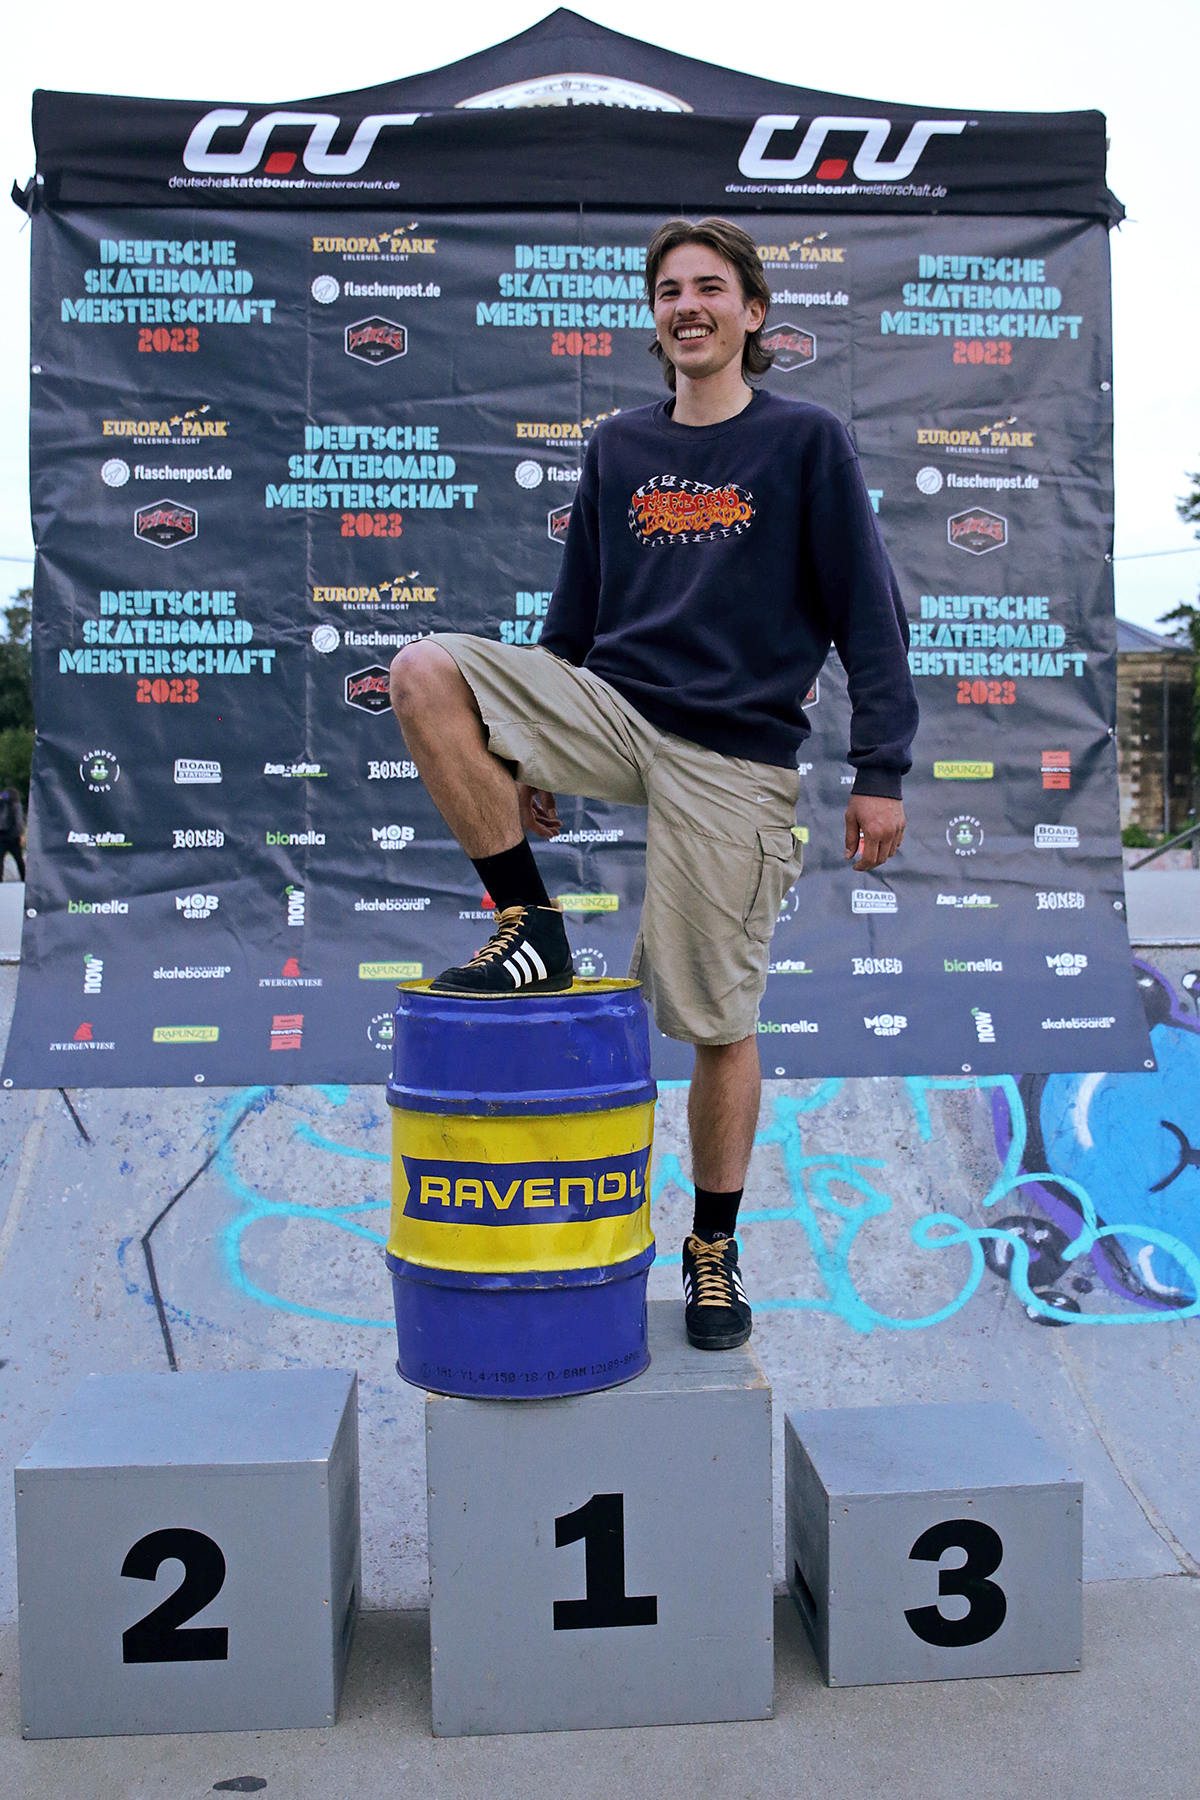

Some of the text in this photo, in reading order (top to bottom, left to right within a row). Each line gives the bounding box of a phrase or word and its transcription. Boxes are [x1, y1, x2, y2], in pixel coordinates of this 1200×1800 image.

[100, 238, 236, 265] DEUTSCHE
[313, 236, 438, 256] EUROPA PARK
[757, 245, 845, 263] OPA PARK
[515, 245, 648, 271] DEUTSCHE
[918, 254, 1046, 282] DEUTSCHE
[84, 269, 253, 294] SKATEBOARD
[344, 282, 440, 299] flaschenpost.de
[499, 273, 648, 299] SKATEBOAR
[771, 289, 849, 307] schenpost.de
[902, 284, 1061, 311] SKATEBOARD
[61, 298, 276, 323] MEISTERSCHAFT
[477, 302, 656, 329] MEISTERSCHA
[881, 308, 1082, 339] MEISTERSCHAFT
[138, 328, 199, 352] 2023
[551, 331, 612, 356] 2023
[953, 341, 1012, 365] 2023
[103, 420, 228, 437] EUROPA PARK
[305, 425, 439, 450] DEUTSCHE
[516, 423, 583, 438] EUROPA
[917, 429, 1036, 447] EUROPA PARK
[134, 465, 232, 483] flaschenpost.de
[288, 454, 455, 479] SKATEBOARD
[947, 474, 1039, 491] flaschenpost.de
[266, 484, 478, 508] MEISTERSCHAFT
[341, 513, 402, 537] 2023
[100, 591, 236, 615] DEUTSCHE
[313, 586, 436, 602] EUROPA PARK
[920, 596, 1049, 620] DEUTSCHE
[83, 620, 253, 644] SKATEBOARD
[344, 631, 434, 649] flaschenpost
[908, 623, 1067, 649] SKATEBOARD
[59, 649, 275, 674] MEISTERSCHAFT
[136, 679, 198, 703] 2023
[957, 681, 1016, 704] 2023
[179, 761, 219, 771] BOARD
[937, 765, 991, 777] RAPUNZEL
[173, 829, 224, 848] BONES
[267, 831, 325, 845] bionella
[370, 823, 416, 842] MOB
[1039, 826, 1076, 836] BOARD
[379, 841, 407, 850] GRIP
[175, 893, 220, 911] MOB
[856, 891, 895, 902] BOARD
[1036, 892, 1085, 910] BONES
[69, 900, 128, 913] bionella
[183, 909, 212, 920] GRIP
[459, 911, 495, 920] ZWERGE
[852, 958, 902, 975] BONES
[944, 959, 1002, 971] bionella
[1045, 952, 1088, 968] MOB
[361, 963, 421, 976] RAPUNZEL
[1055, 967, 1082, 977] GRIP
[758, 1020, 818, 1033] bionella
[863, 1014, 908, 1030] MOB
[157, 1028, 217, 1040] RAPUNZEL
[873, 1027, 901, 1037] GRIP
[50, 1042, 115, 1050] ZWERGENWIESE
[420, 1169, 642, 1210] RAVENOL
[553, 1494, 657, 1630] 1
[904, 1520, 1006, 1647] 3
[121, 1528, 228, 1663] 2
